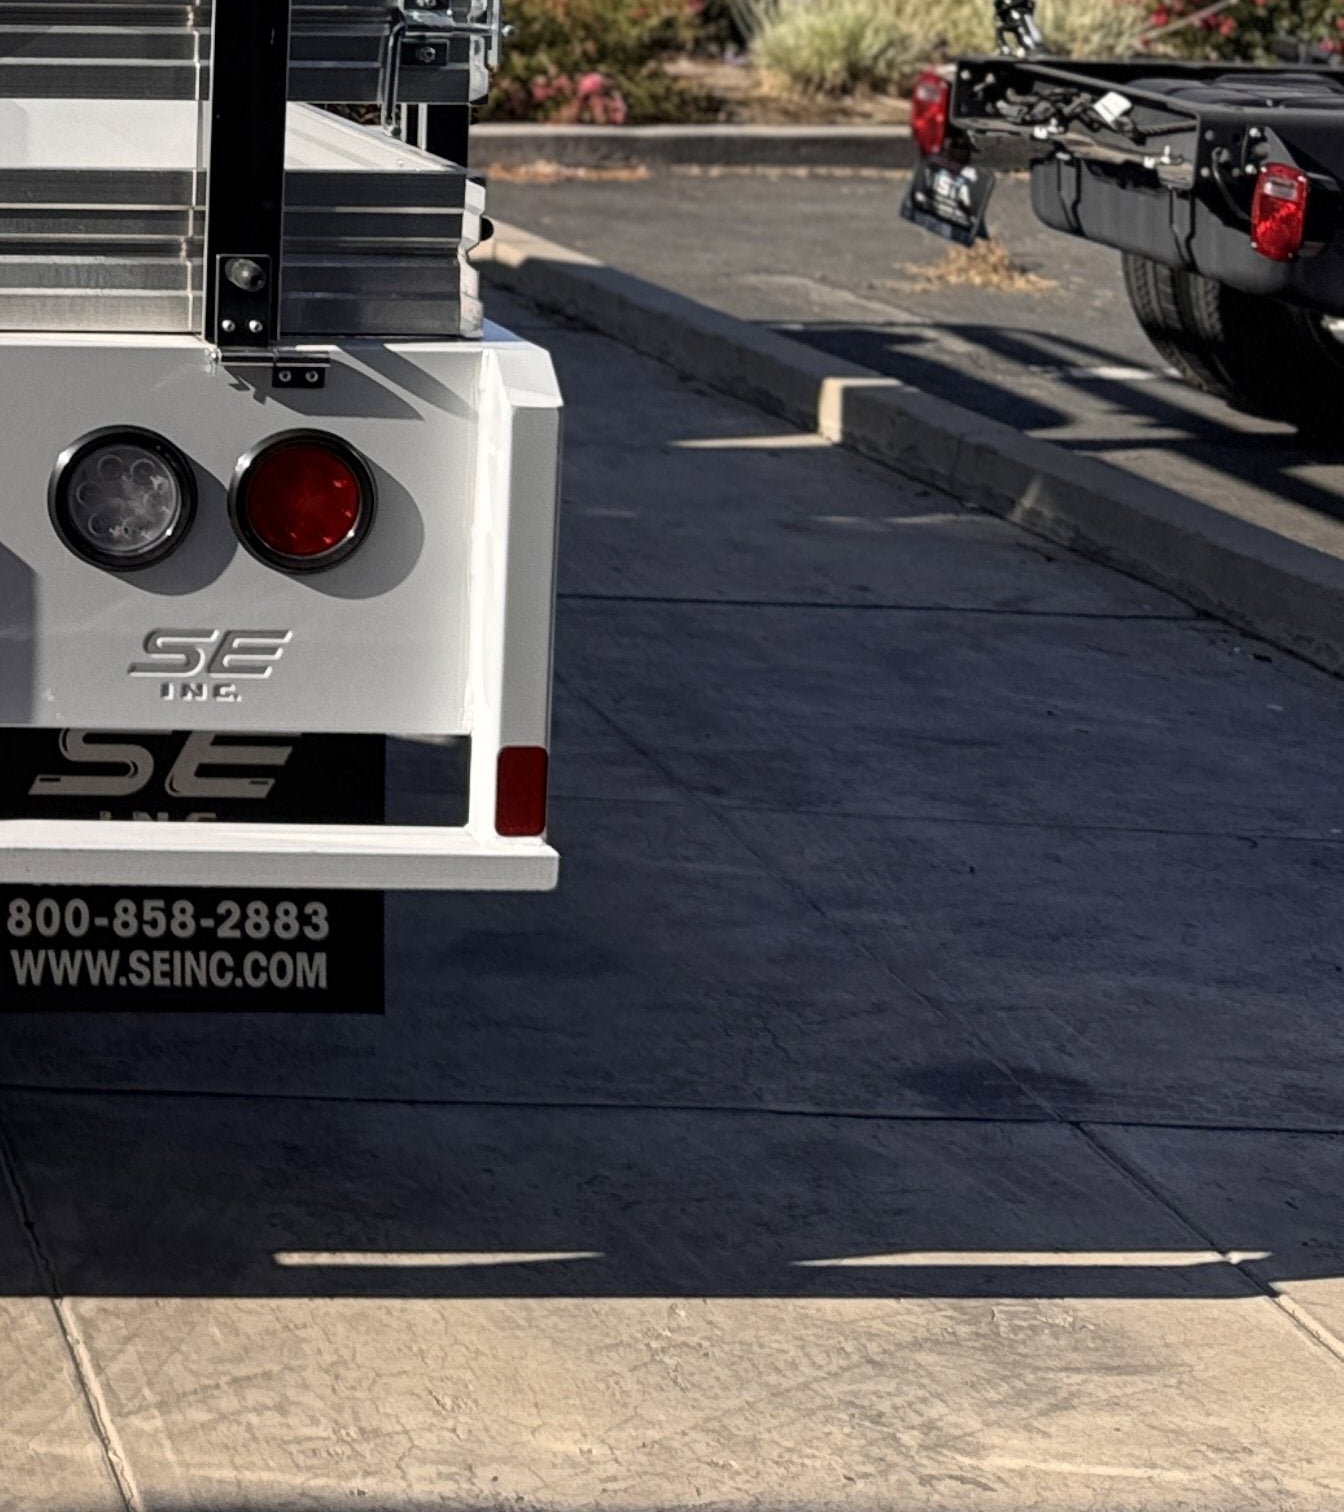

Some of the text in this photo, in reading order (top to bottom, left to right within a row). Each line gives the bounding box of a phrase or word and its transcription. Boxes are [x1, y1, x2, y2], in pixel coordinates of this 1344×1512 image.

[127, 628, 294, 679] SE
[28, 728, 300, 800] SE
[7, 898, 329, 940] 800-858-2883
[10, 949, 328, 990] WWW.SEINC.COM
